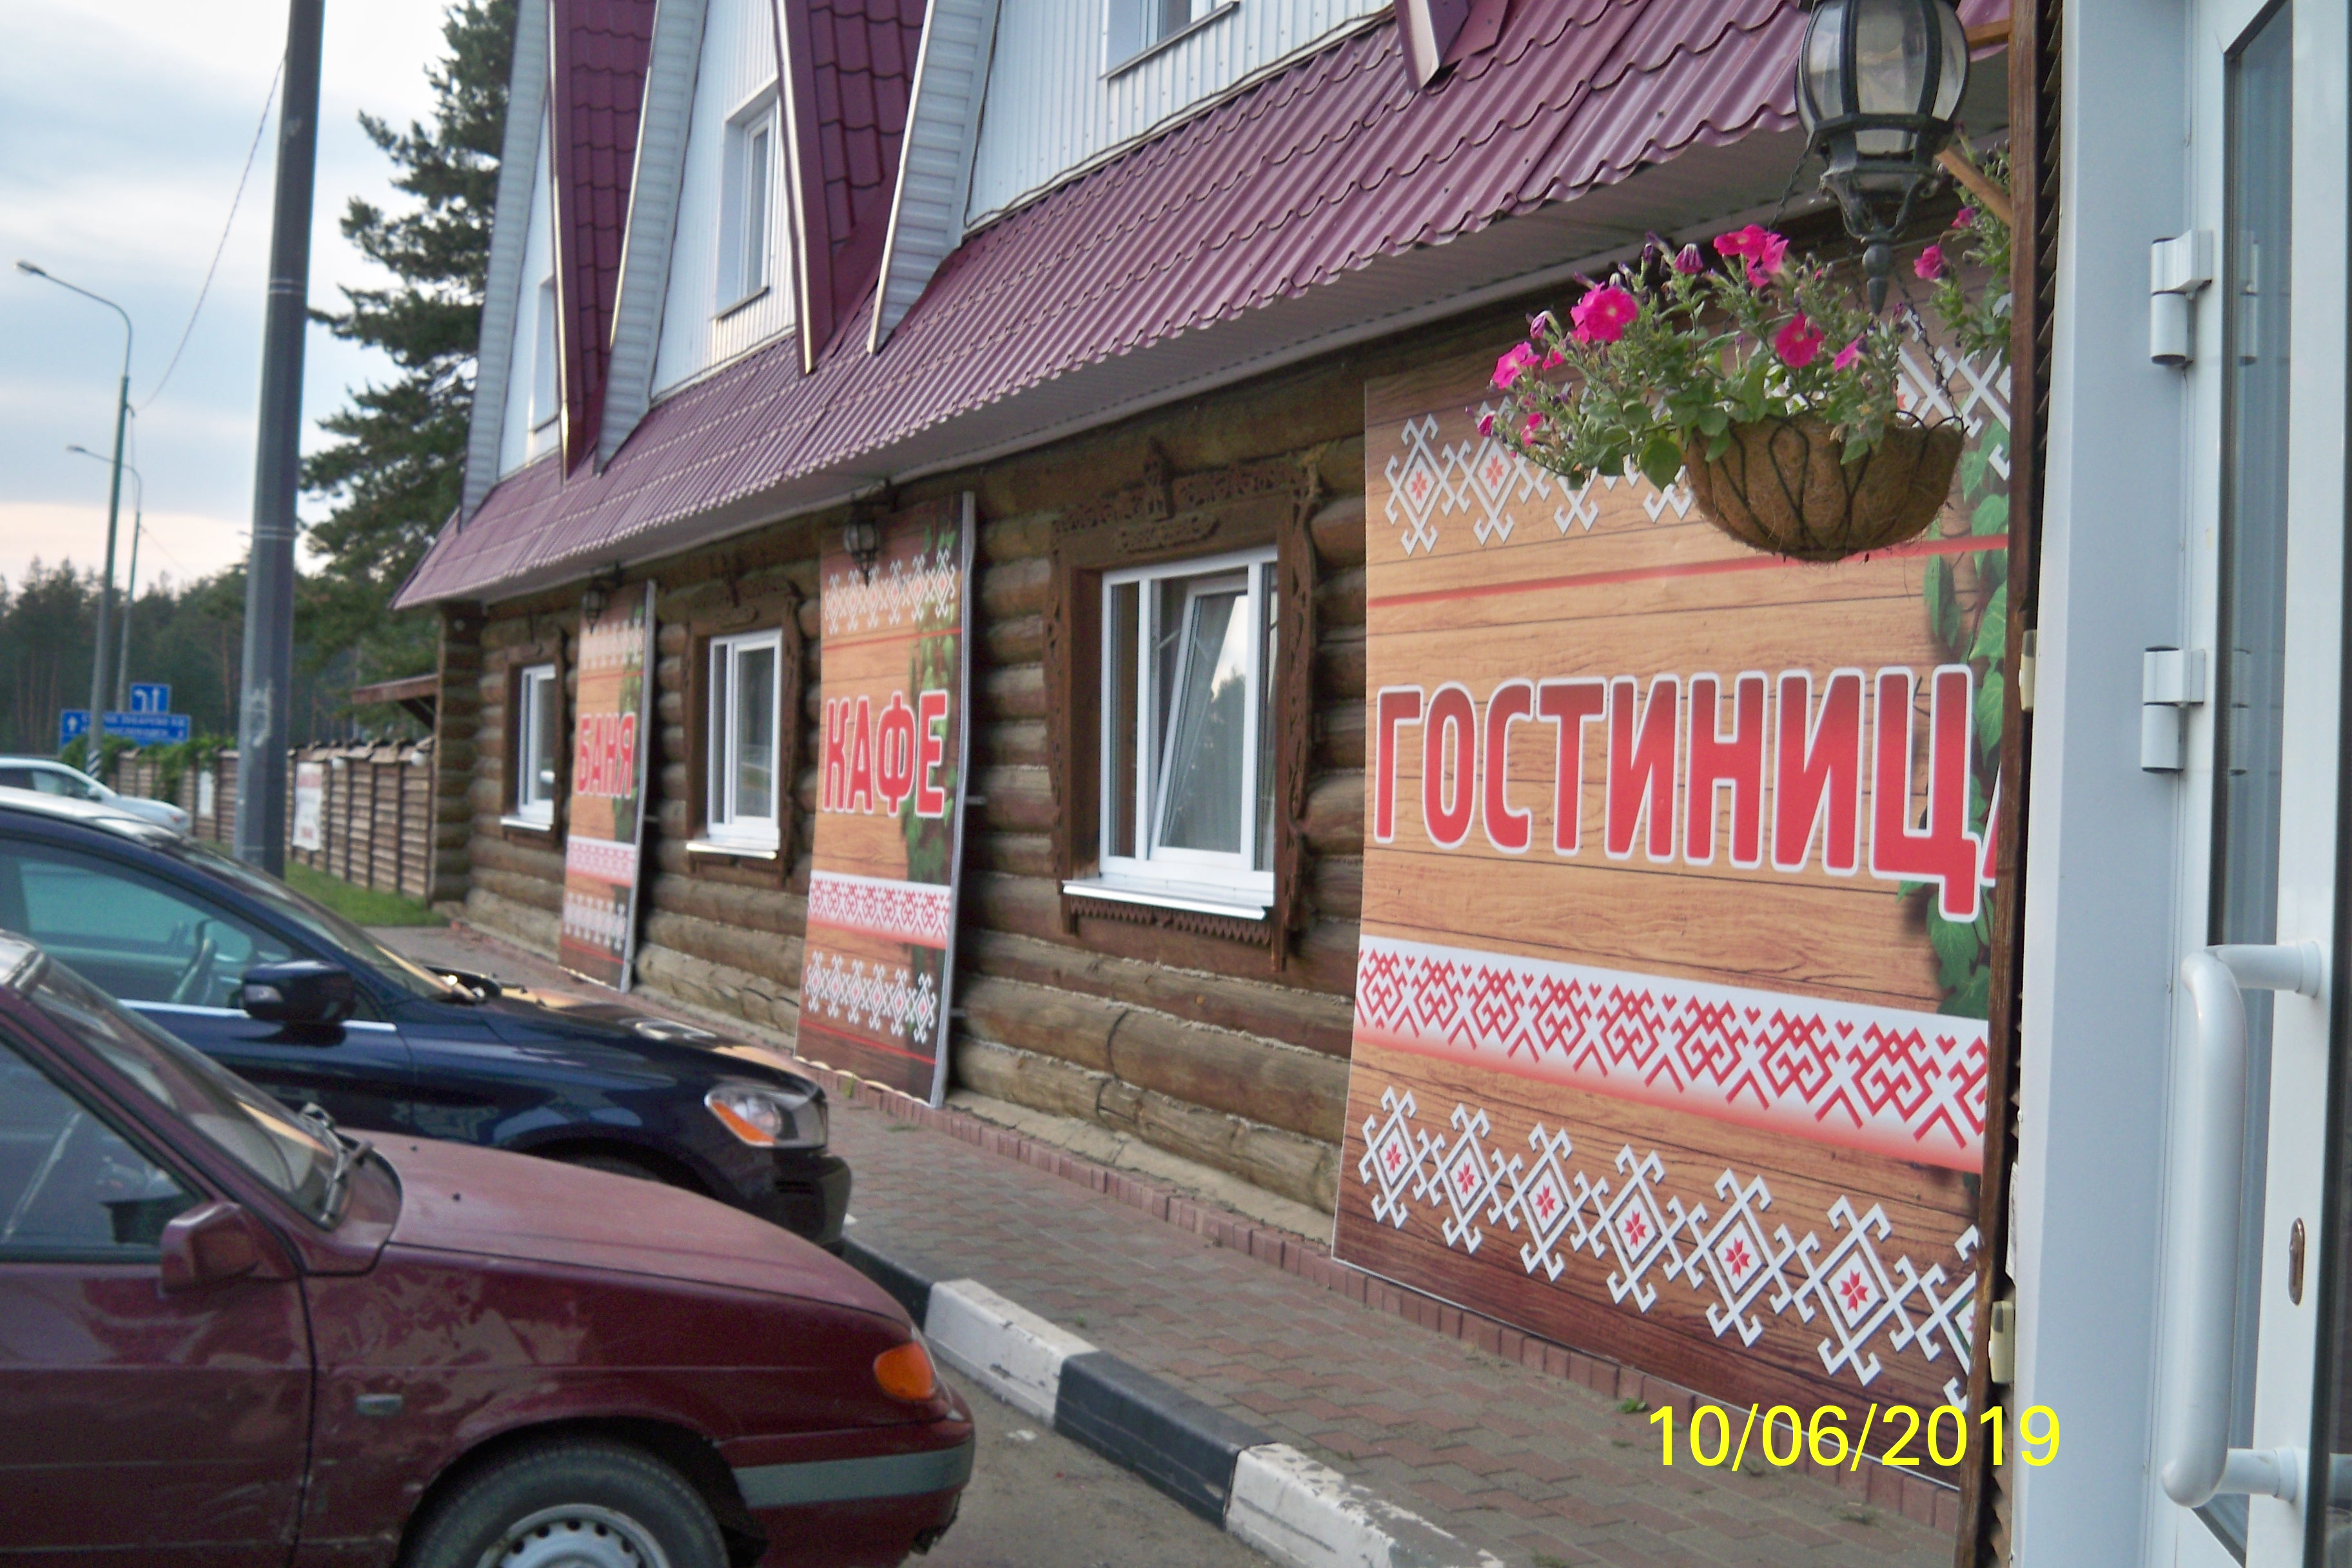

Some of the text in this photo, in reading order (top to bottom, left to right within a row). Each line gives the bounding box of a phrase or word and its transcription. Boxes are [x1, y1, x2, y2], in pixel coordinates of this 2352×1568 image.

[577, 712, 635, 799] БАНЯ
[823, 691, 948, 818] КАФЕ
[1375, 664, 2001, 923] ГОСТИНИЦ
